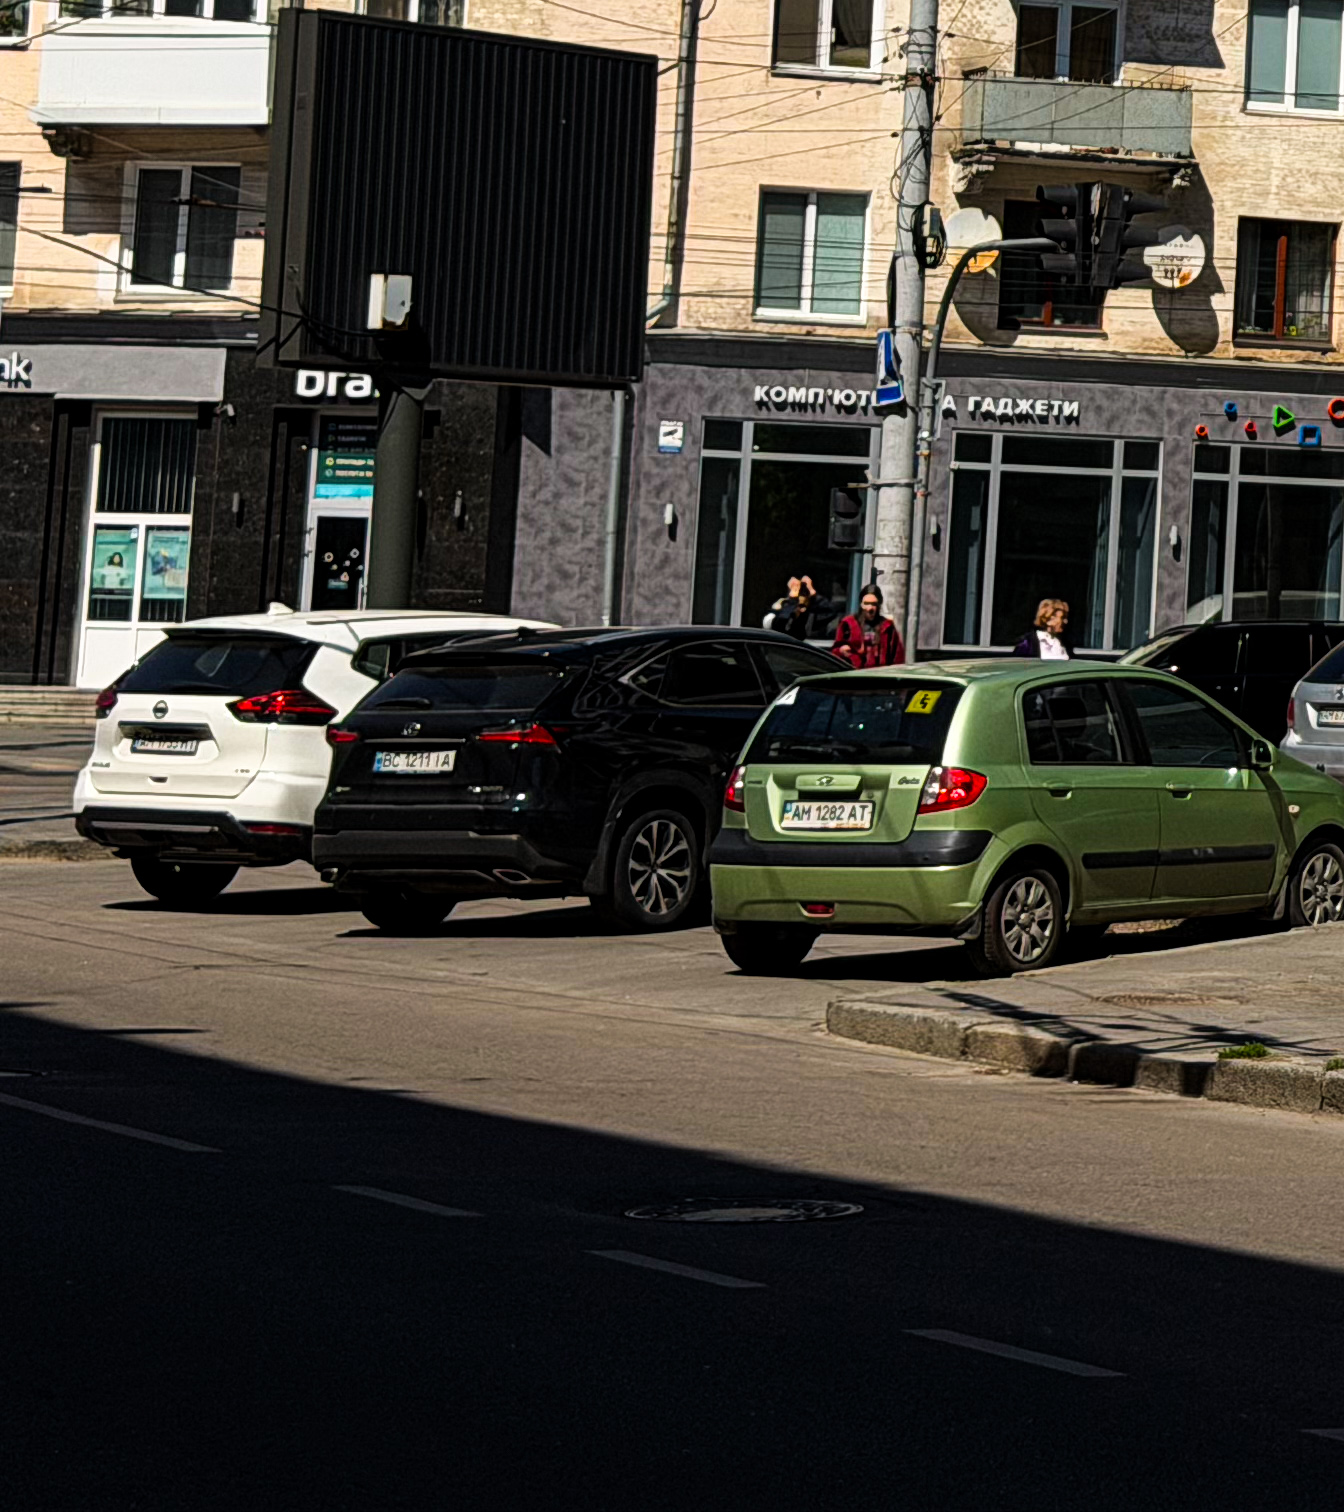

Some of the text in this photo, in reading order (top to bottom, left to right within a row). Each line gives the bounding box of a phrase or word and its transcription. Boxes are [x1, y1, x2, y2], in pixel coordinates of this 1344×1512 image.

[967, 396, 1080, 418] ГАДЖЕТИ
[382, 752, 400, 768] BC
[790, 804, 870, 822] AM 1282 AT
